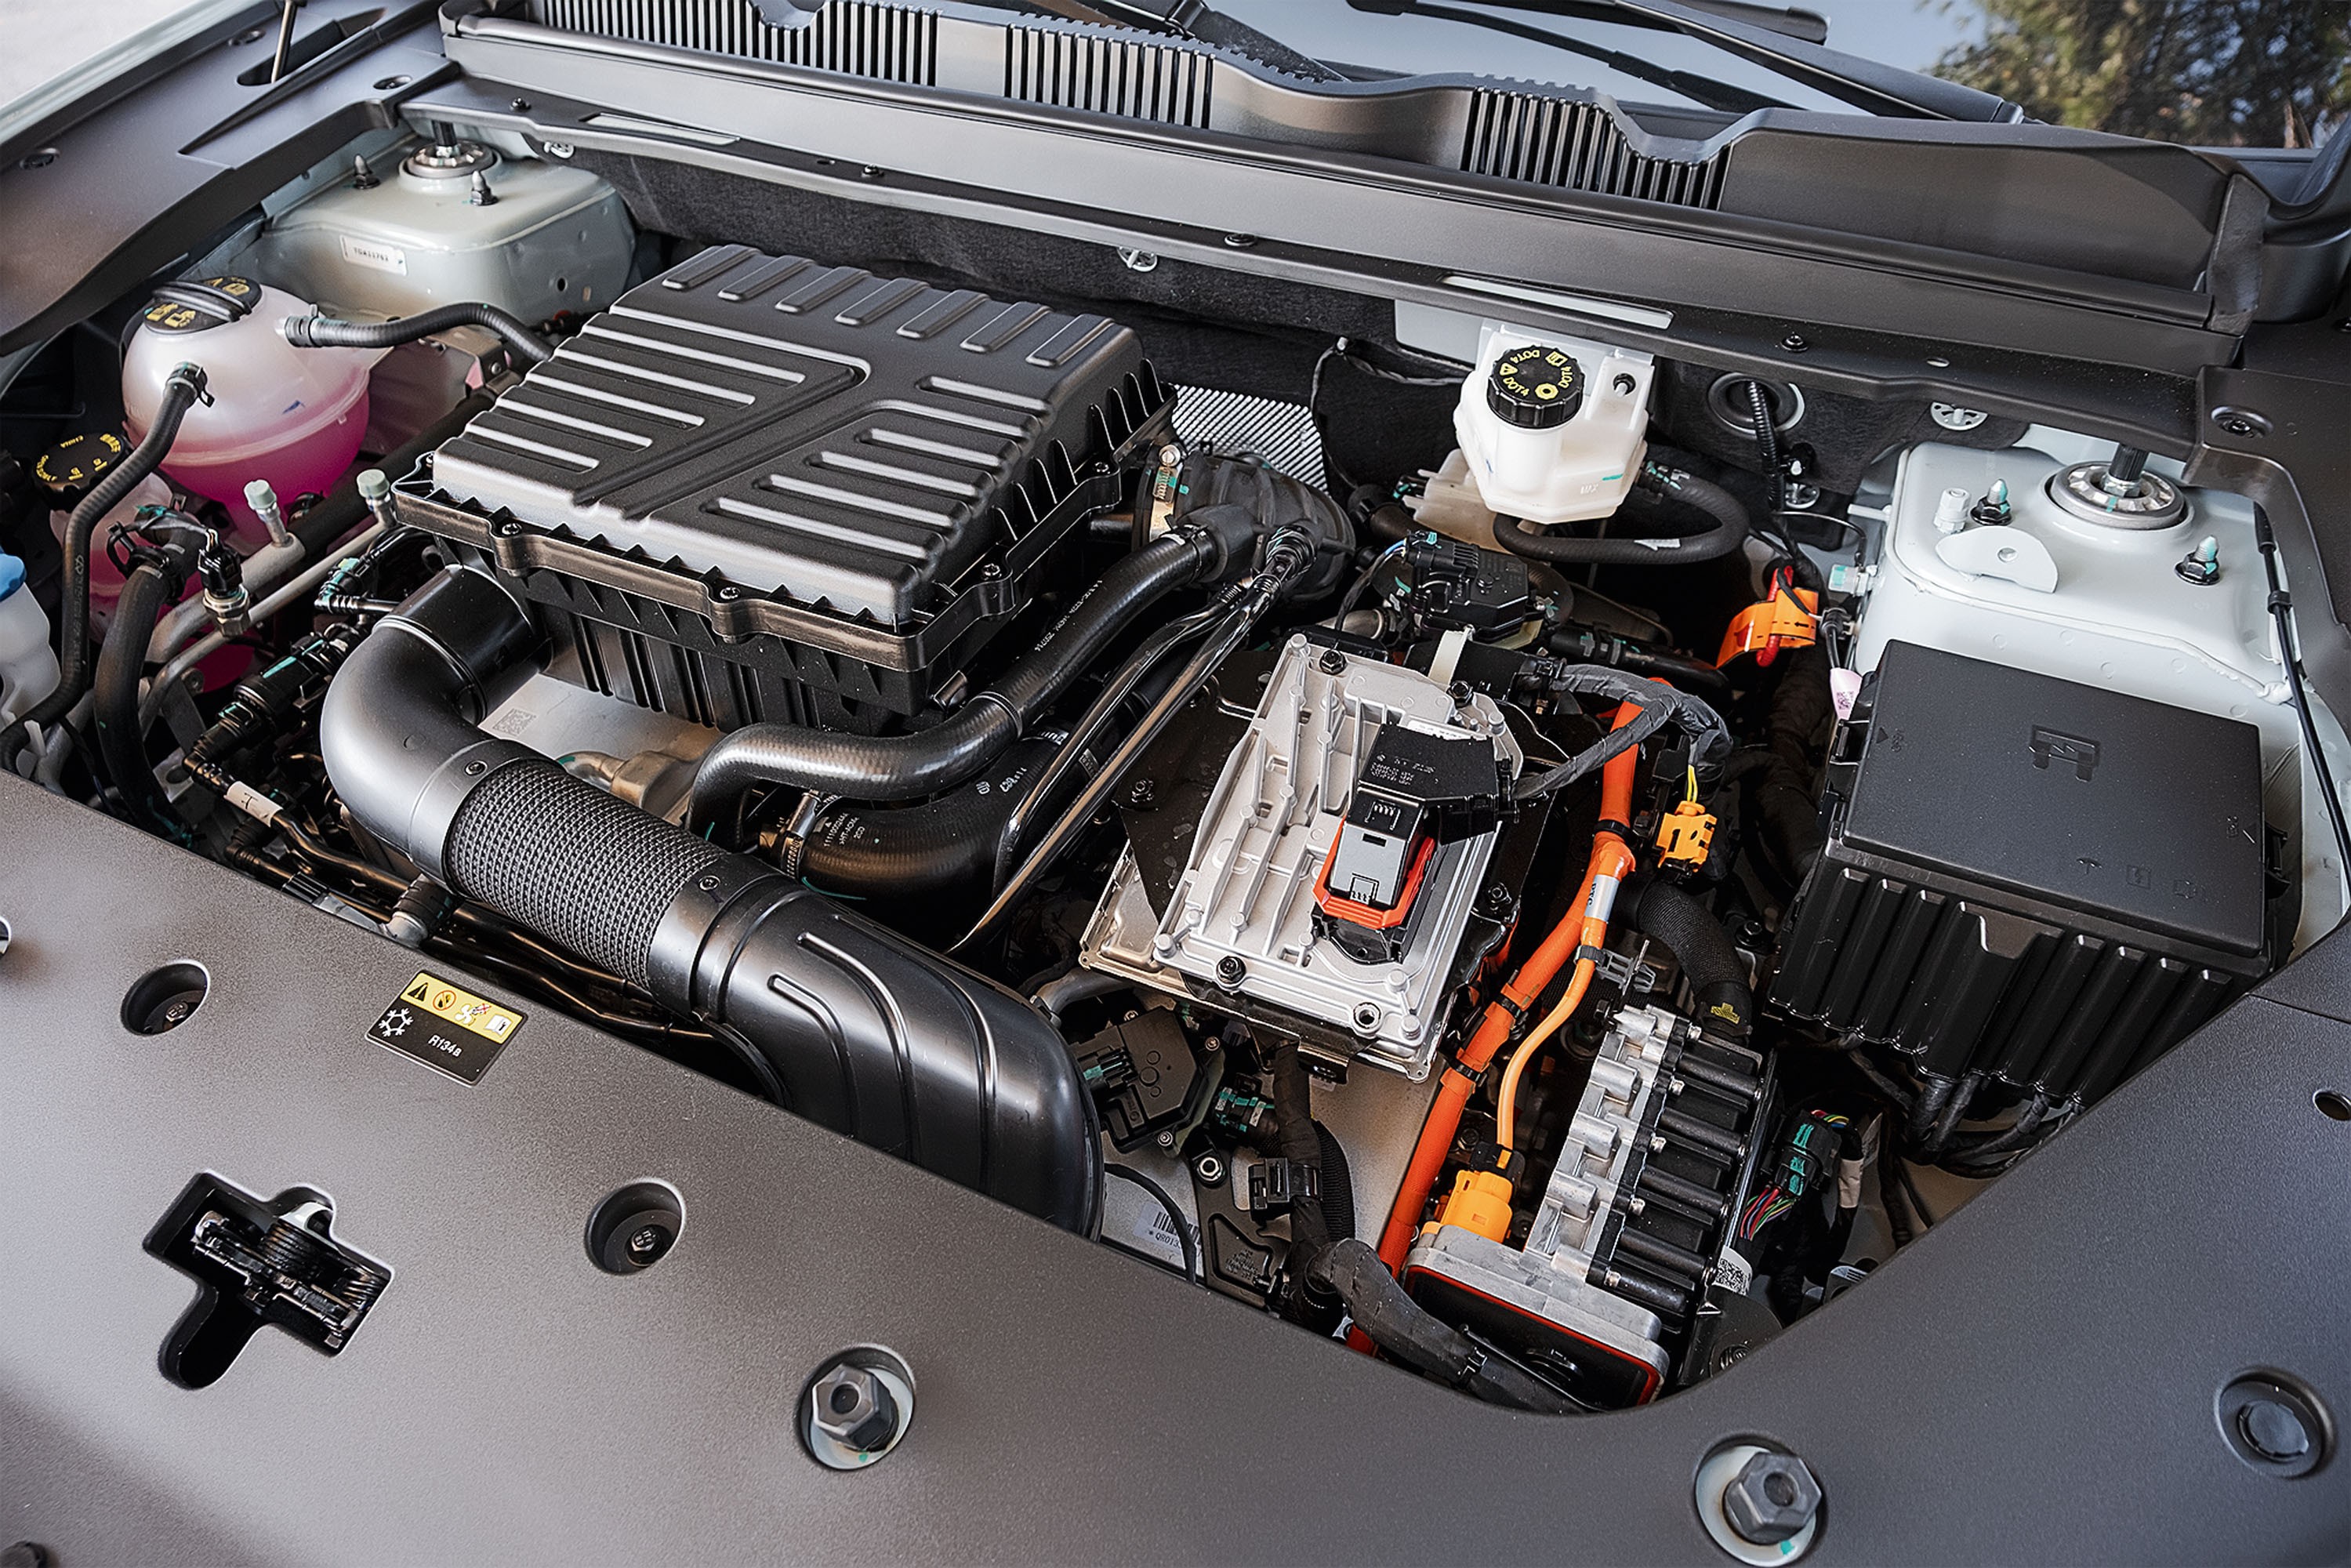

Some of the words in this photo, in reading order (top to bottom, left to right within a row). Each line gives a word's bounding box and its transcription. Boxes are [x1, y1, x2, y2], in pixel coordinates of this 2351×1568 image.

[1510, 350, 1540, 364] DOT4
[1503, 376, 1530, 397] DOT4
[1558, 366, 1573, 389] DOT4
[427, 1034, 463, 1058] R134a
